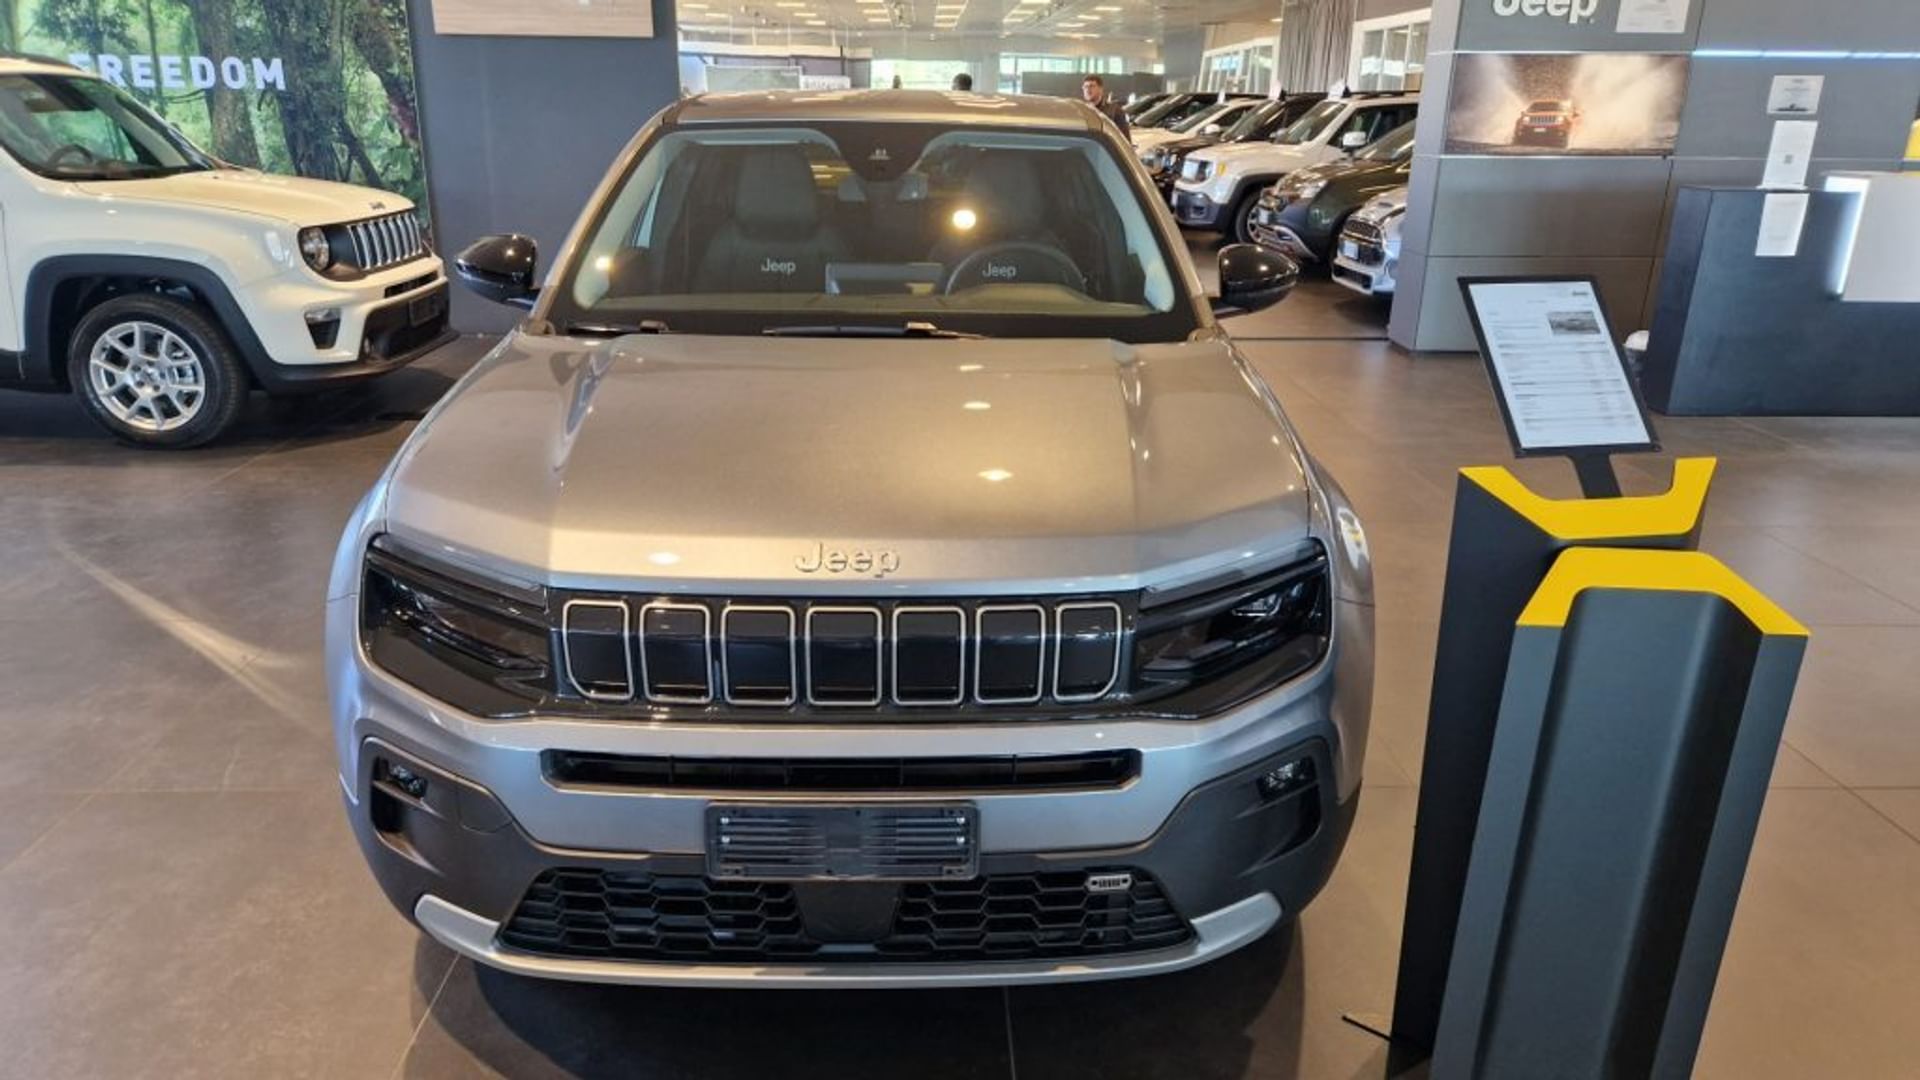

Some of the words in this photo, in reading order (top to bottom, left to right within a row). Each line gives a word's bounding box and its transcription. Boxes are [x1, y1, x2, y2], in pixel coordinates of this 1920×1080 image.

[68, 54, 286, 90] FREEDOM
[760, 257, 796, 276] Jeep
[982, 260, 1016, 280] Jeep
[794, 541, 900, 579] Jeep
